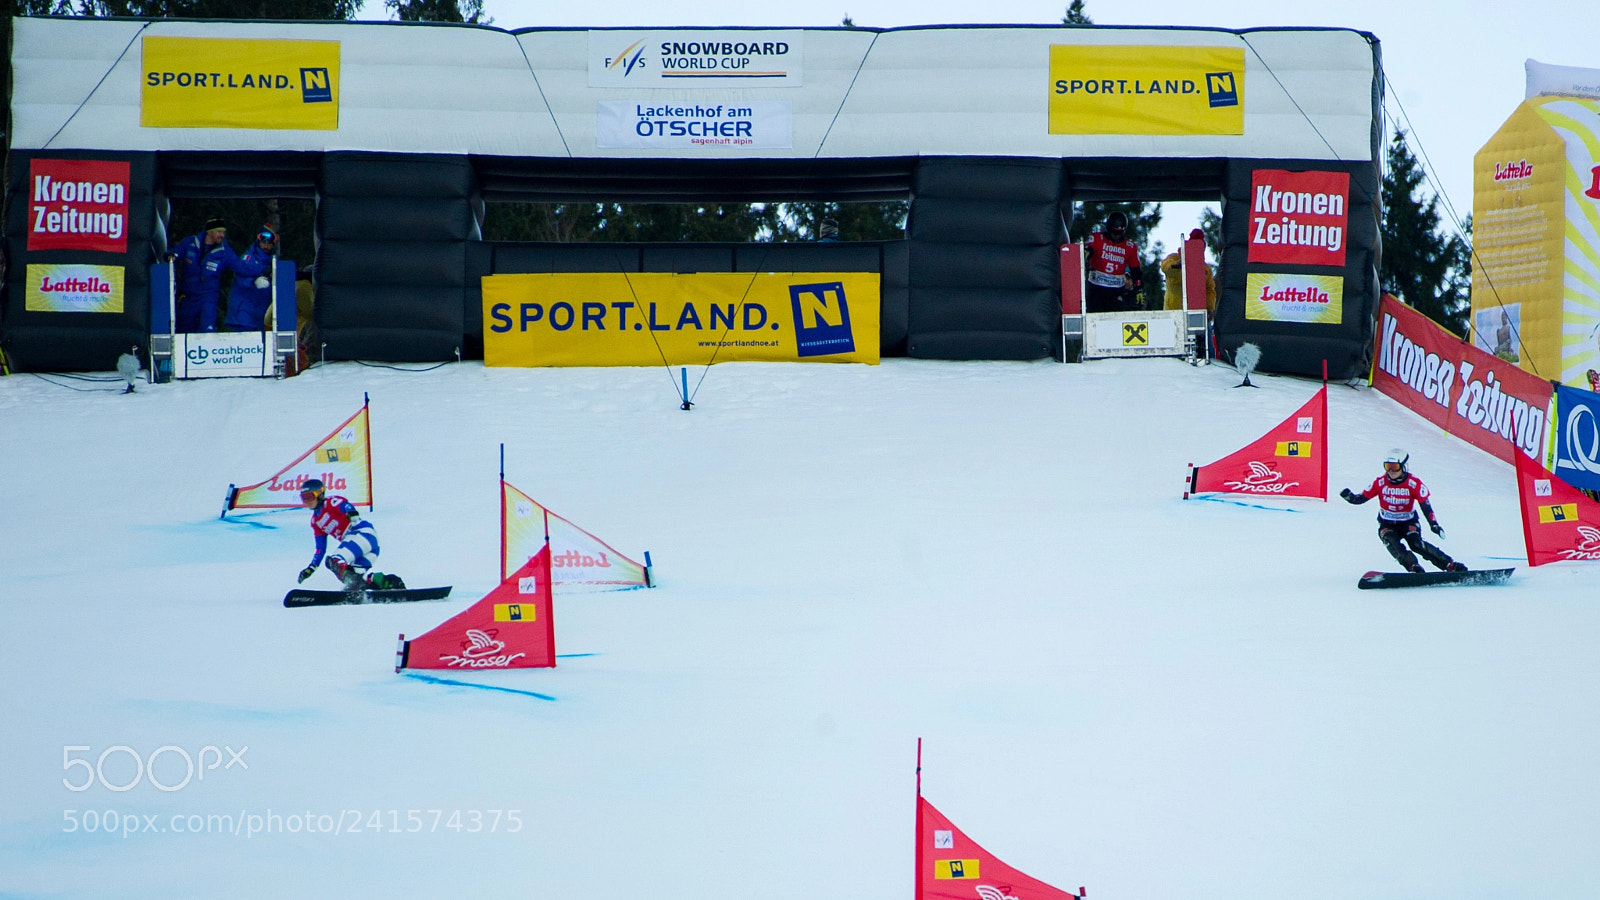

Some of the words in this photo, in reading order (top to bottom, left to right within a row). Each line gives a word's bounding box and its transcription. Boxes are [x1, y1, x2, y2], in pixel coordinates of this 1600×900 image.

[661, 42, 789, 56] SNOWBOARD
[662, 57, 717, 69] WORLD
[721, 57, 750, 69] CUP
[147, 71, 294, 90] SPORT.LAND.
[1055, 79, 1201, 94] SPORT.LAND.
[636, 104, 723, 118] Lackenhof
[727, 107, 753, 117] am
[636, 117, 752, 137] ÖTSCHER
[691, 138, 731, 146] sagenhaft
[733, 138, 753, 146] alpin
[1494, 160, 1533, 180] Lattella
[34, 175, 124, 204] Kronen
[1255, 185, 1343, 216] Kronen
[33, 205, 123, 239] Zeitung
[1253, 216, 1342, 252] Zeitung
[1103, 243, 1126, 255] Kronen
[1101, 251, 1125, 264] Zeitung
[40, 277, 110, 293] Lattella
[1260, 286, 1329, 304] Lattella
[490, 301, 780, 333] SPORT.LAND.
[187, 345, 209, 360] cb
[212, 345, 263, 355] cashback
[212, 355, 243, 364] world
[1379, 312, 1455, 409] Kronen
[1456, 360, 1544, 460] Zeitung
[267, 472, 347, 491] Lattlla
[1223, 481, 1299, 493] moser
[1382, 485, 1410, 496] Kronen
[439, 652, 525, 667] moser
